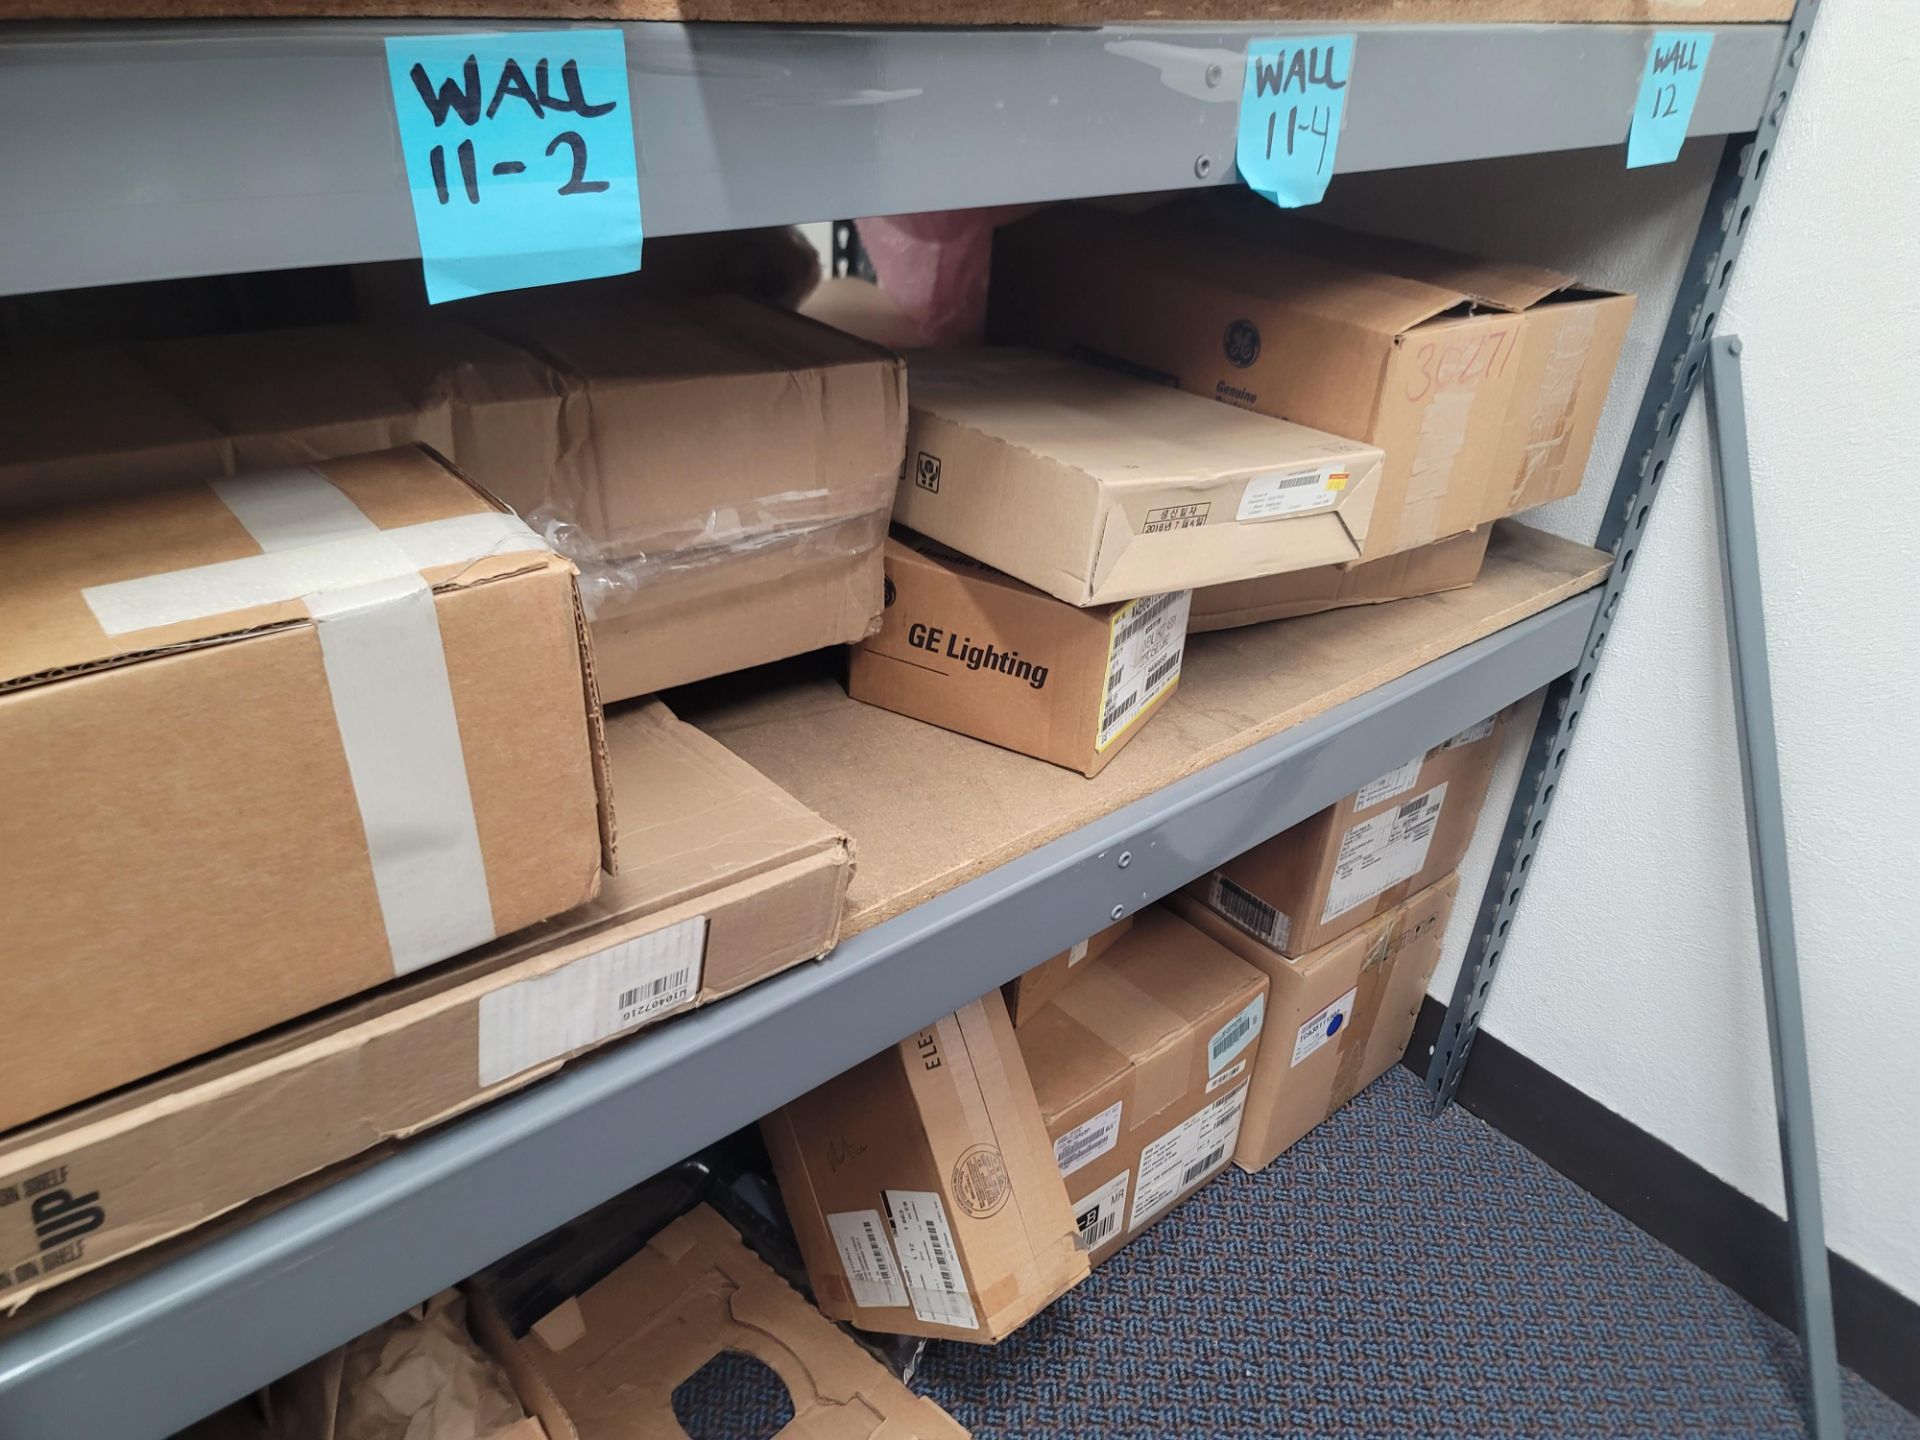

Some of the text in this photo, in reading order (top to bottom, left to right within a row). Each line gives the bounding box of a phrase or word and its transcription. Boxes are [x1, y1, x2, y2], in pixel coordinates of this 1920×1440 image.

[410, 53, 617, 128] WALL
[1255, 45, 1347, 98] WALL
[1652, 40, 1699, 75] WALL
[1651, 83, 1679, 119] 12
[429, 130, 611, 205] 11-2
[1265, 104, 1331, 176] 11-4
[907, 622, 1050, 690] GE Lighting
[31, 1187, 106, 1251] UP
